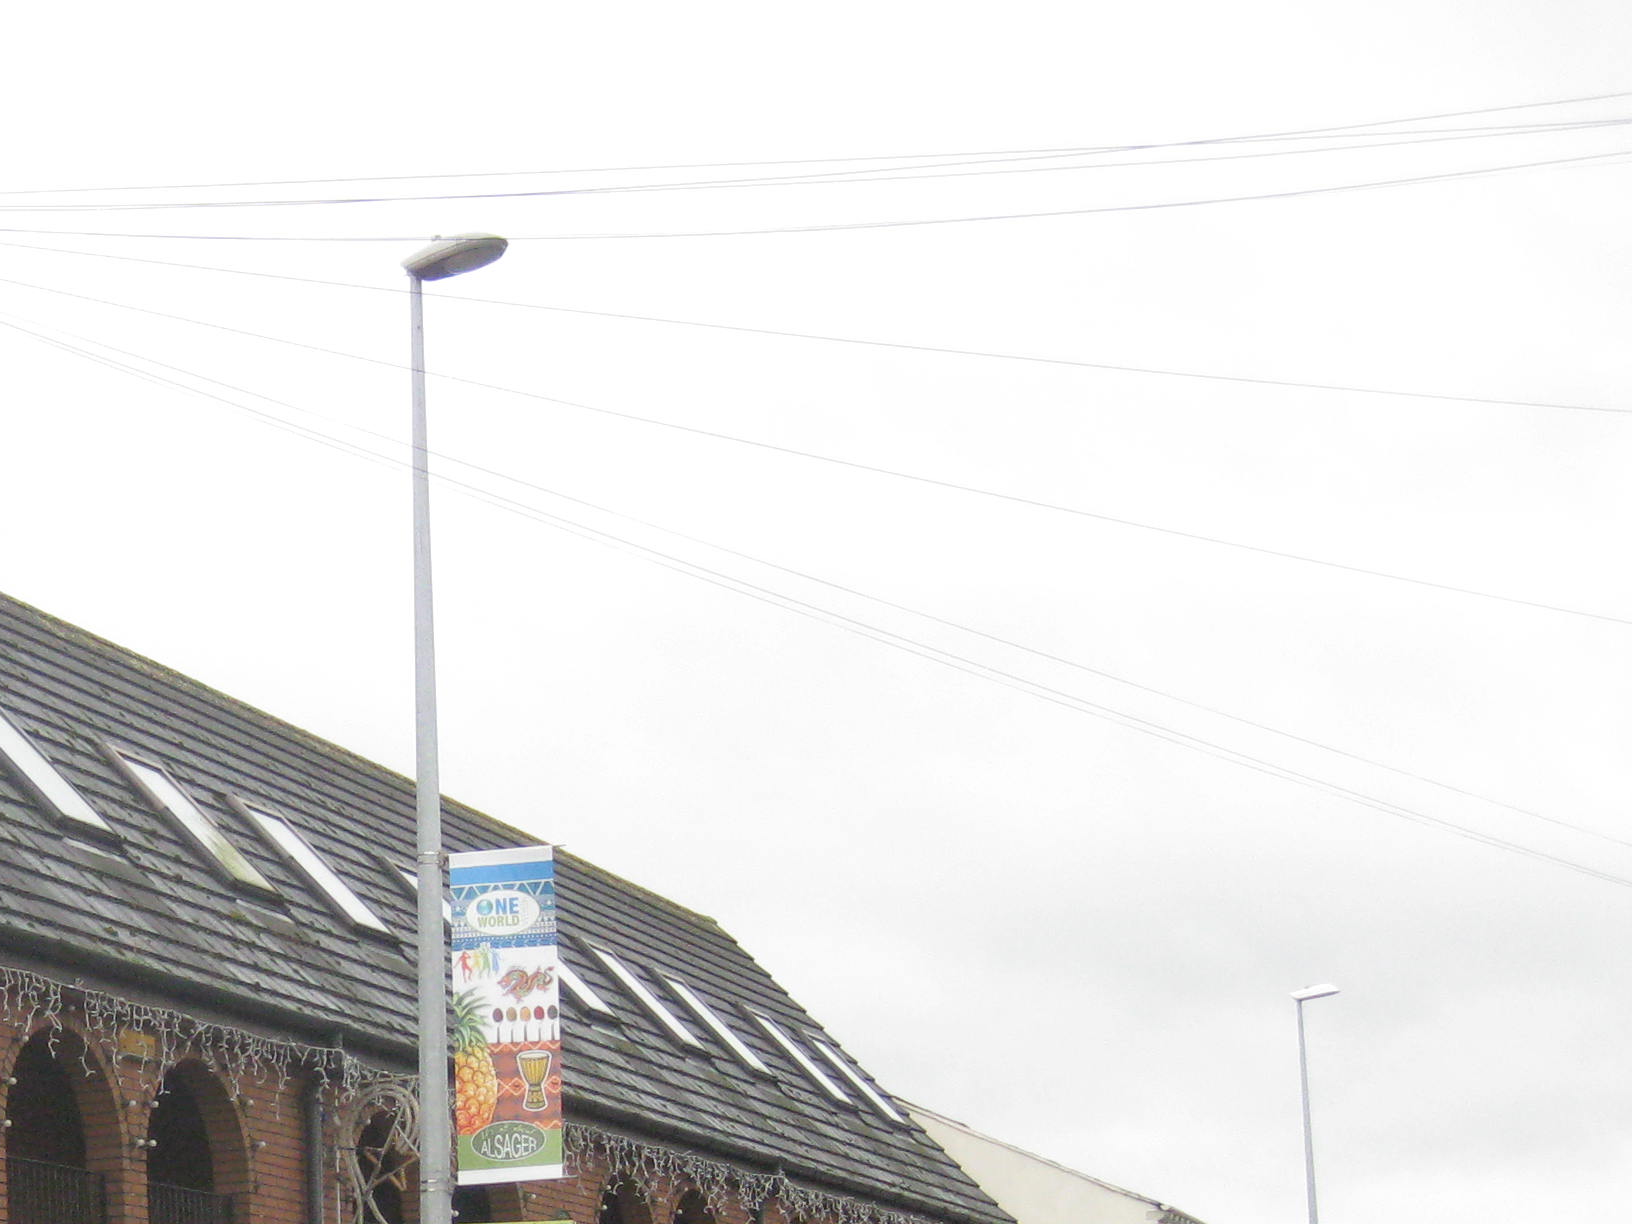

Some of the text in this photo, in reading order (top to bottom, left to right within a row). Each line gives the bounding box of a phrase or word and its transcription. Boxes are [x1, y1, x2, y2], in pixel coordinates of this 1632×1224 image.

[476, 897, 519, 915] ONE
[477, 915, 520, 928] WORLD
[481, 1133, 537, 1158] ALSAGER
